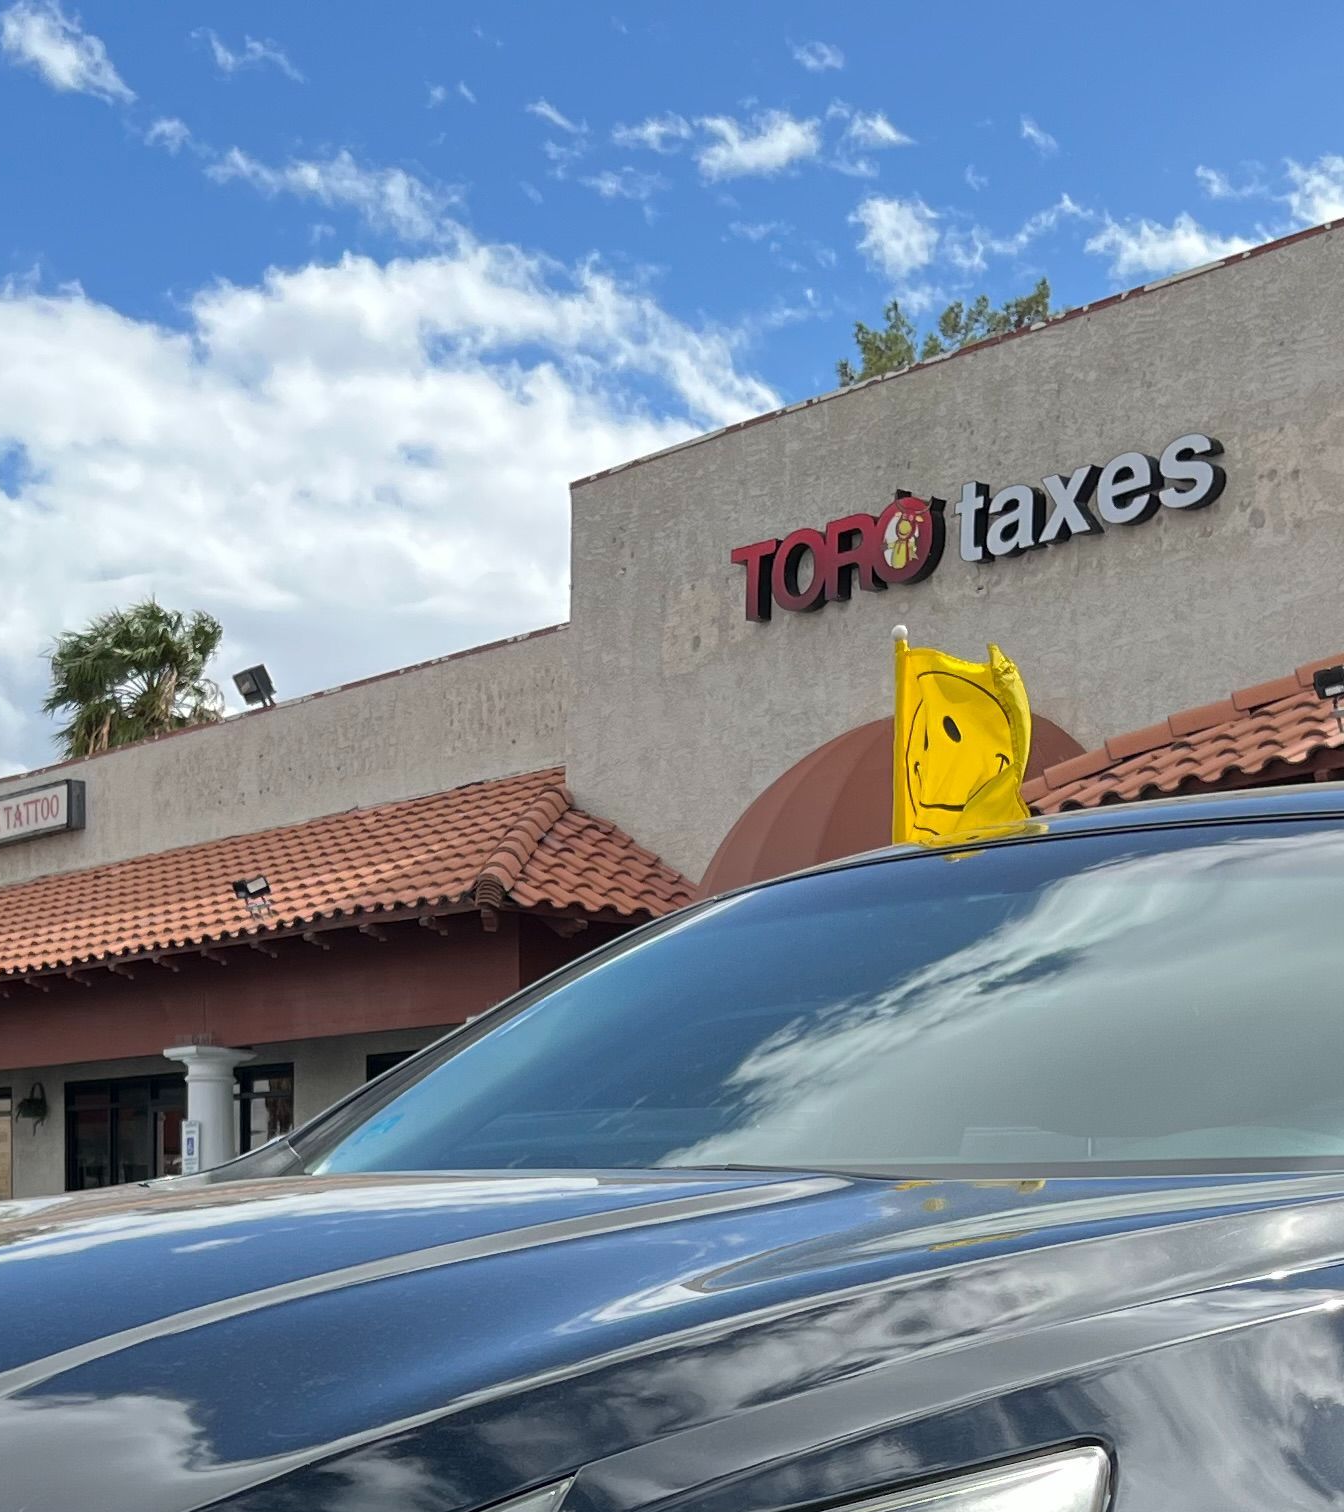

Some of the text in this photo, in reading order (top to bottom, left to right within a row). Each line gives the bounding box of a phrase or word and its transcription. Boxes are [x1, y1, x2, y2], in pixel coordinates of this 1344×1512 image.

[731, 432, 1222, 622] TORO taxes
[4, 794, 60, 829] TATTOO
